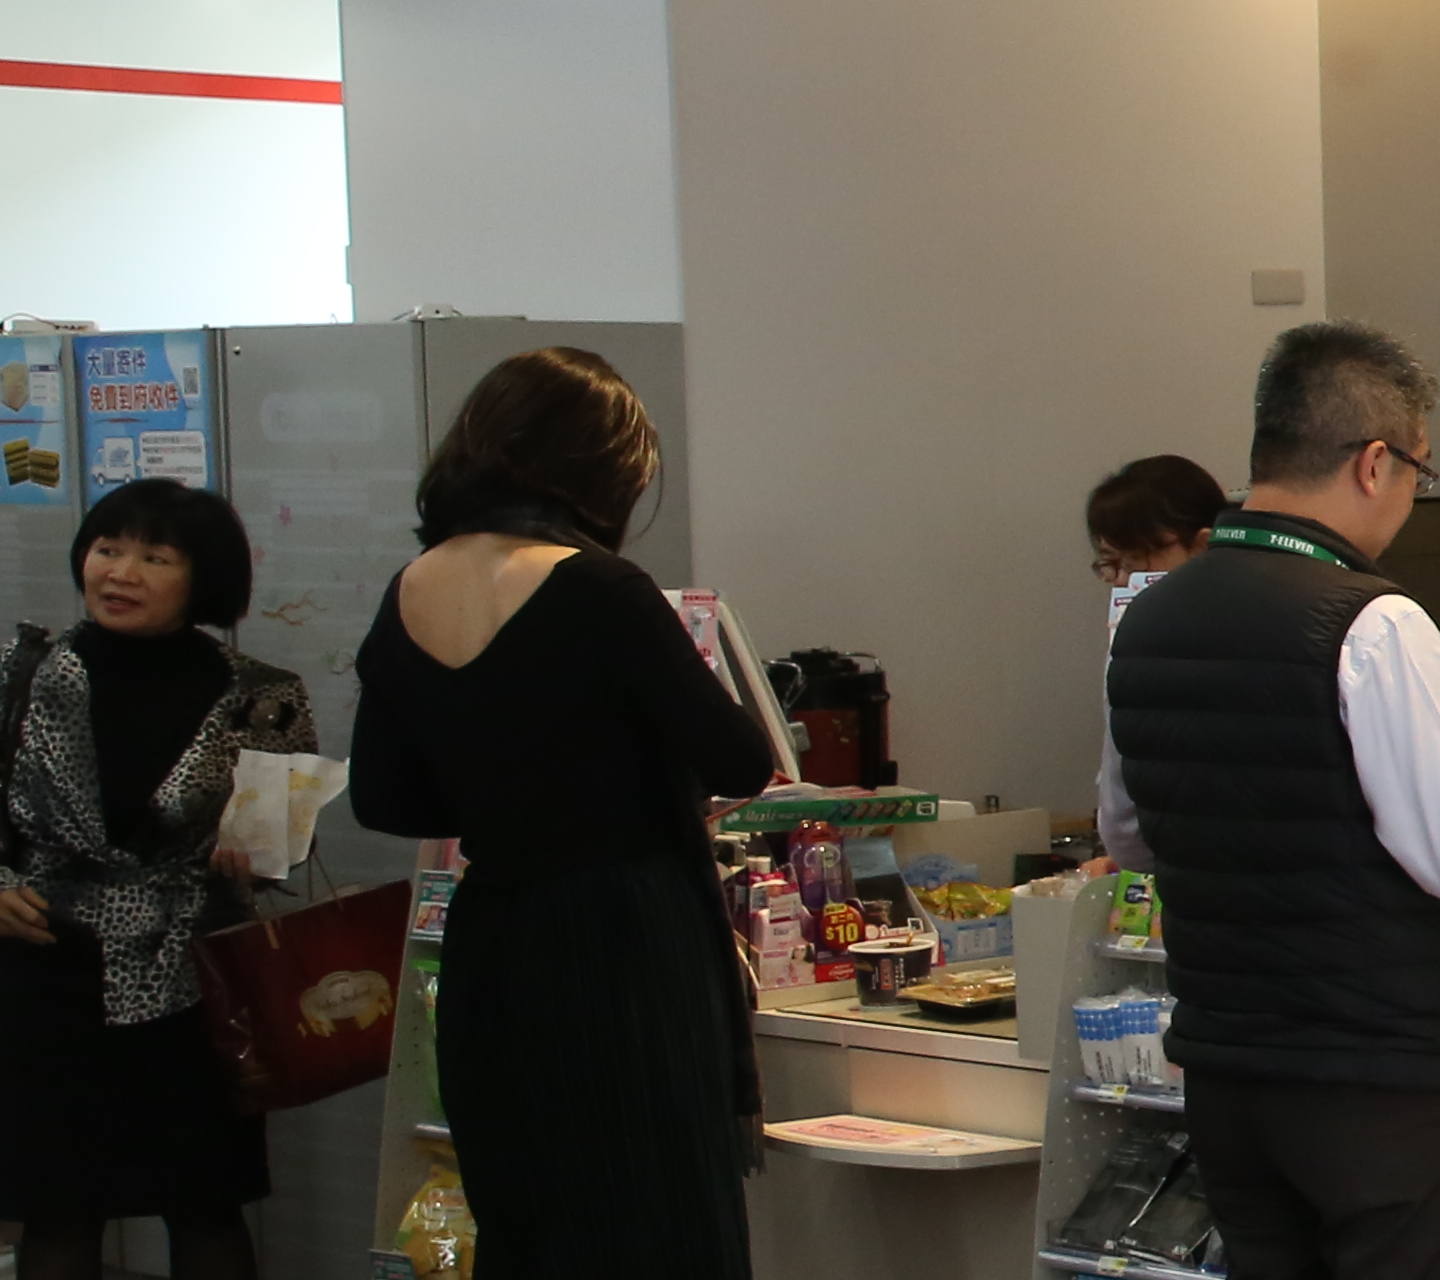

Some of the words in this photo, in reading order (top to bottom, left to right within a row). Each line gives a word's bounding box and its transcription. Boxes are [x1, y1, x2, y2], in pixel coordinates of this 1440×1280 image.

[87, 347, 146, 378] 大量寄件
[89, 382, 178, 412] 免費到府收件
[826, 923, 858, 942] $10
